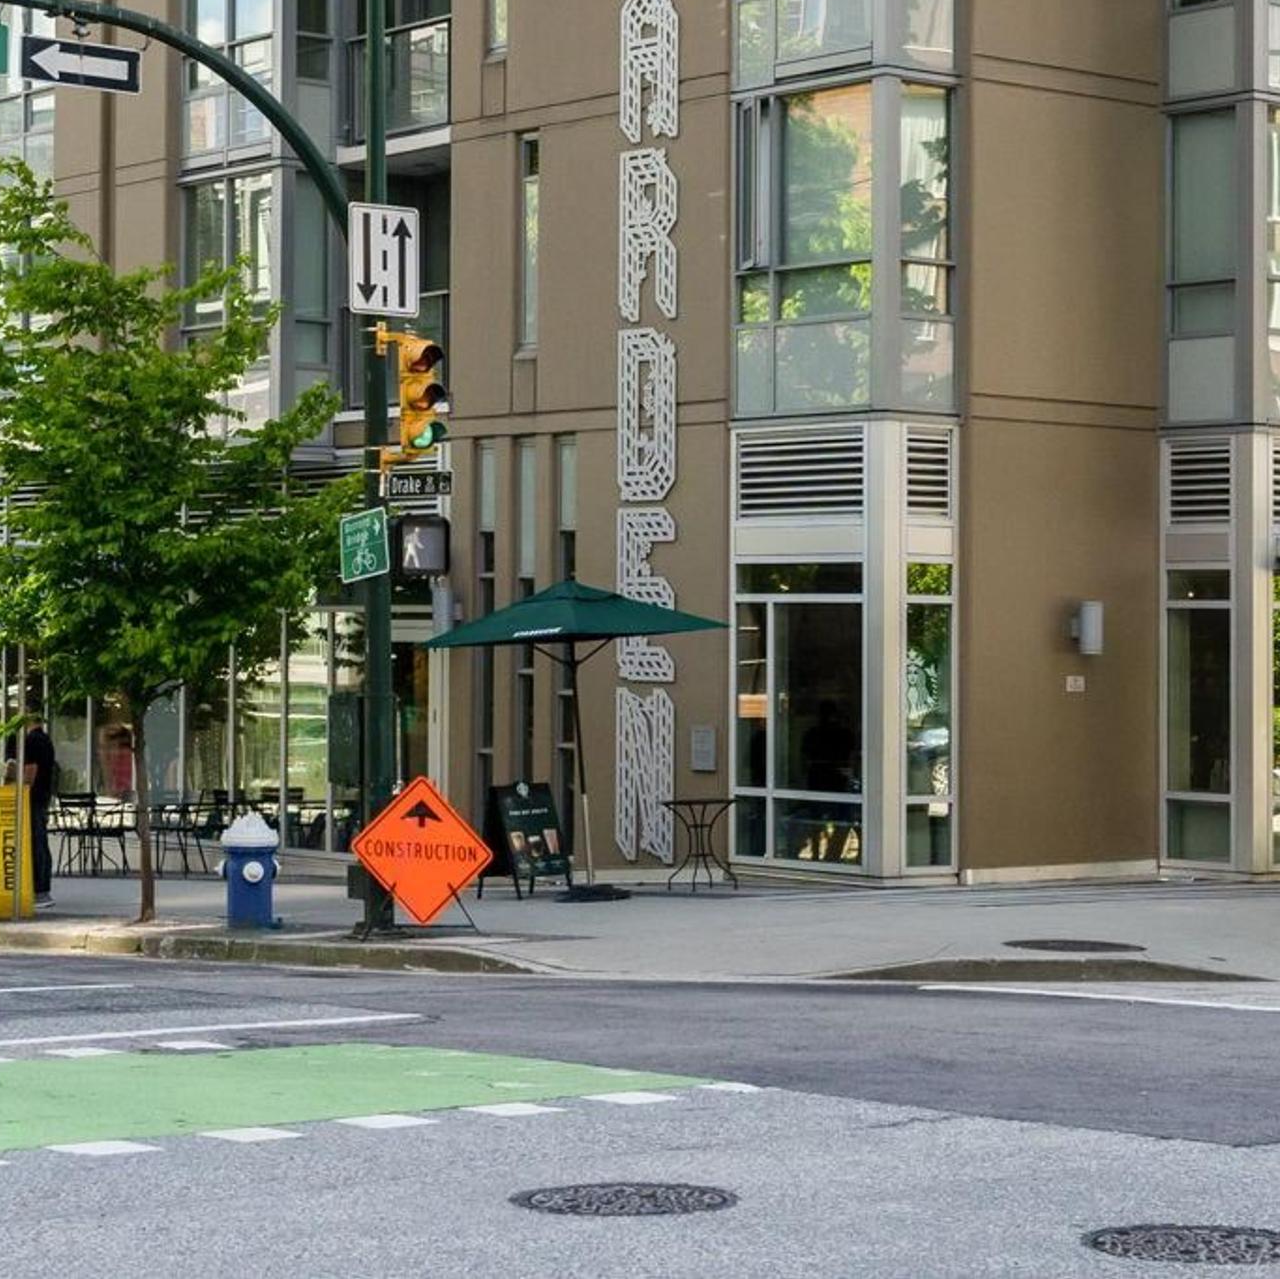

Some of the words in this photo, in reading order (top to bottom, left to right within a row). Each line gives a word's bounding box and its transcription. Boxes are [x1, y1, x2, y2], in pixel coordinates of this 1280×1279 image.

[392, 475, 422, 494] Drake
[3, 830, 16, 891] FREE
[364, 839, 477, 863] CONSTRUCTION
